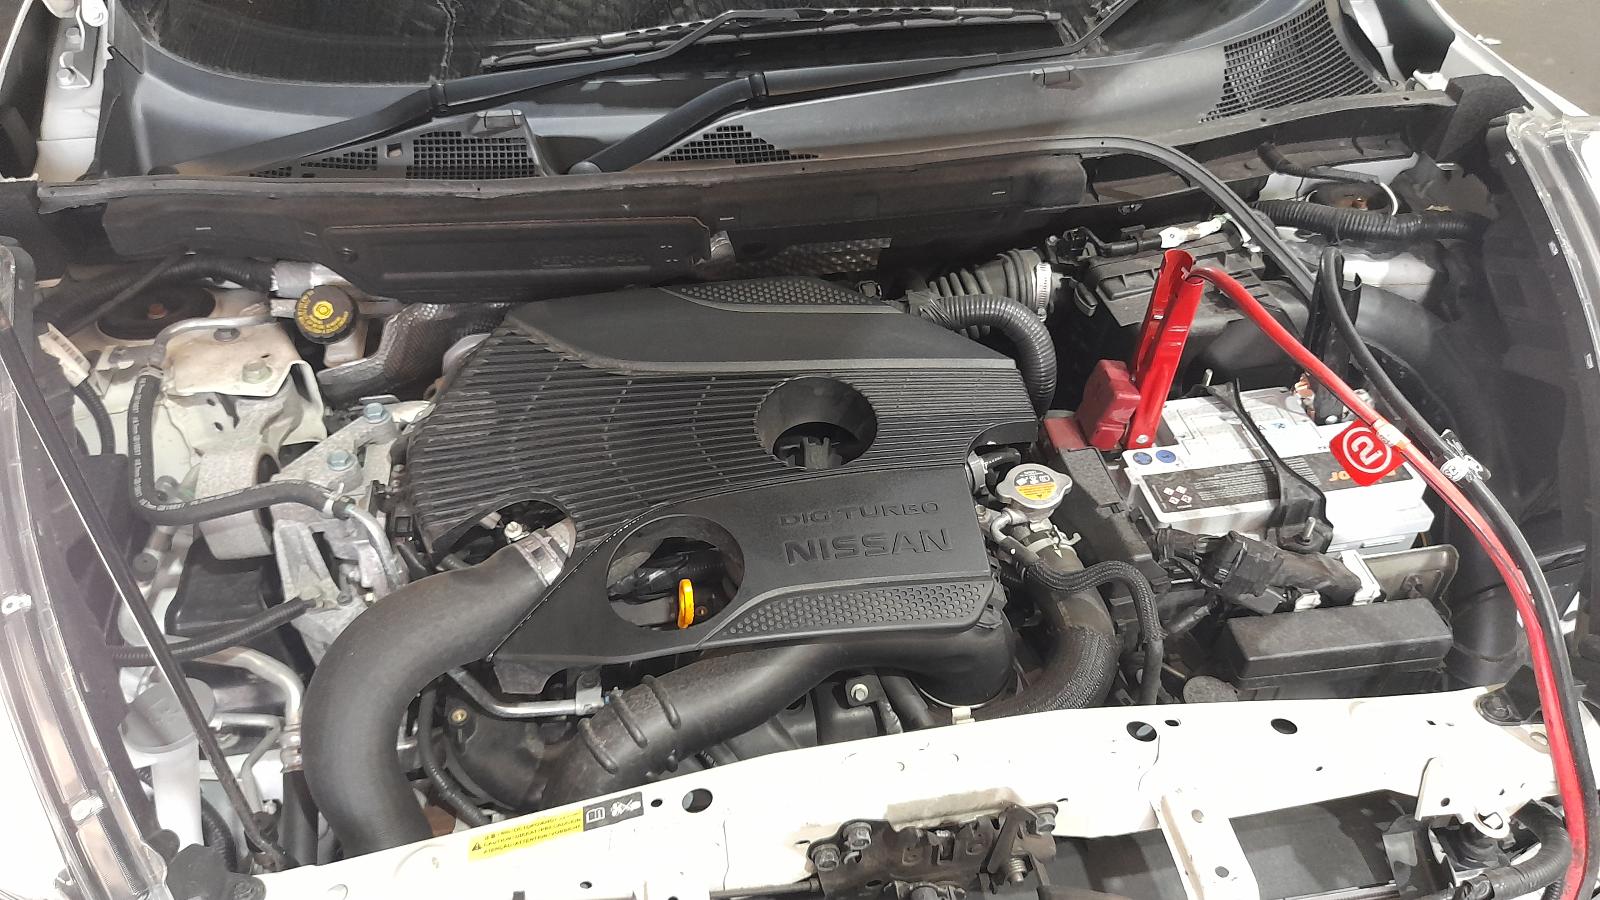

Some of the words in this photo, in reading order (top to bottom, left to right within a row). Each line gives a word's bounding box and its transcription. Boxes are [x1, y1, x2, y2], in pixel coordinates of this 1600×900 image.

[1351, 436, 1383, 465] 2
[780, 511, 830, 526] DIG
[837, 501, 939, 519] TURBO
[785, 528, 953, 565] NISSAN
